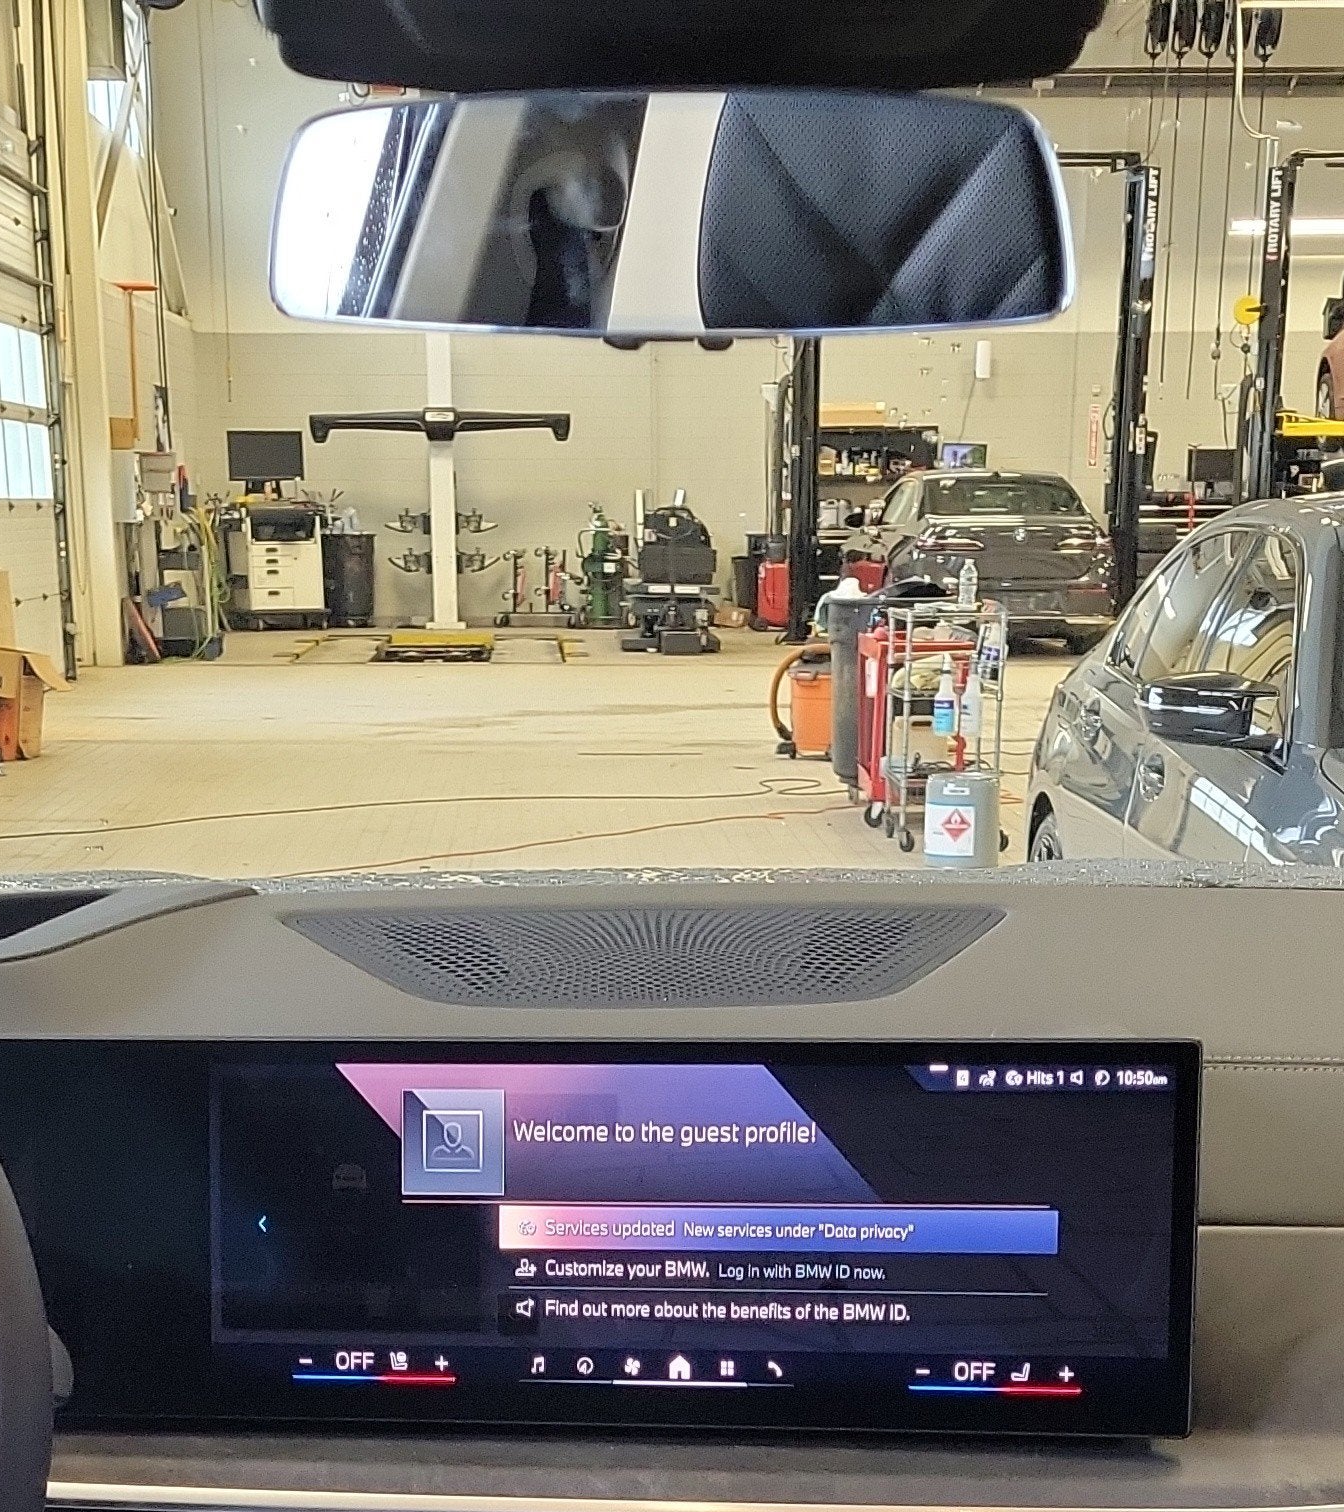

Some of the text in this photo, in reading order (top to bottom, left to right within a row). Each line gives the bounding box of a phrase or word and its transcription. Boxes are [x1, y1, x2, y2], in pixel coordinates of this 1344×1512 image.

[1148, 168, 1159, 197] LIFT
[1267, 168, 1283, 252] ROTARY LIFT
[1027, 1070, 1064, 1086] Hits 1
[513, 1120, 817, 1147] Welcome to the guest profile!
[545, 1219, 608, 1237] Services
[613, 1220, 675, 1239] updated
[684, 1222, 714, 1237] New
[717, 1223, 772, 1238] services
[776, 1224, 816, 1239] under
[545, 1259, 886, 1280] Customize your BMW. Log in with BMW ID now.
[545, 1299, 910, 1321] Find out more about the benefits of the BMW ID.
[335, 1352, 375, 1370] OFF
[954, 1361, 996, 1382] OFF
